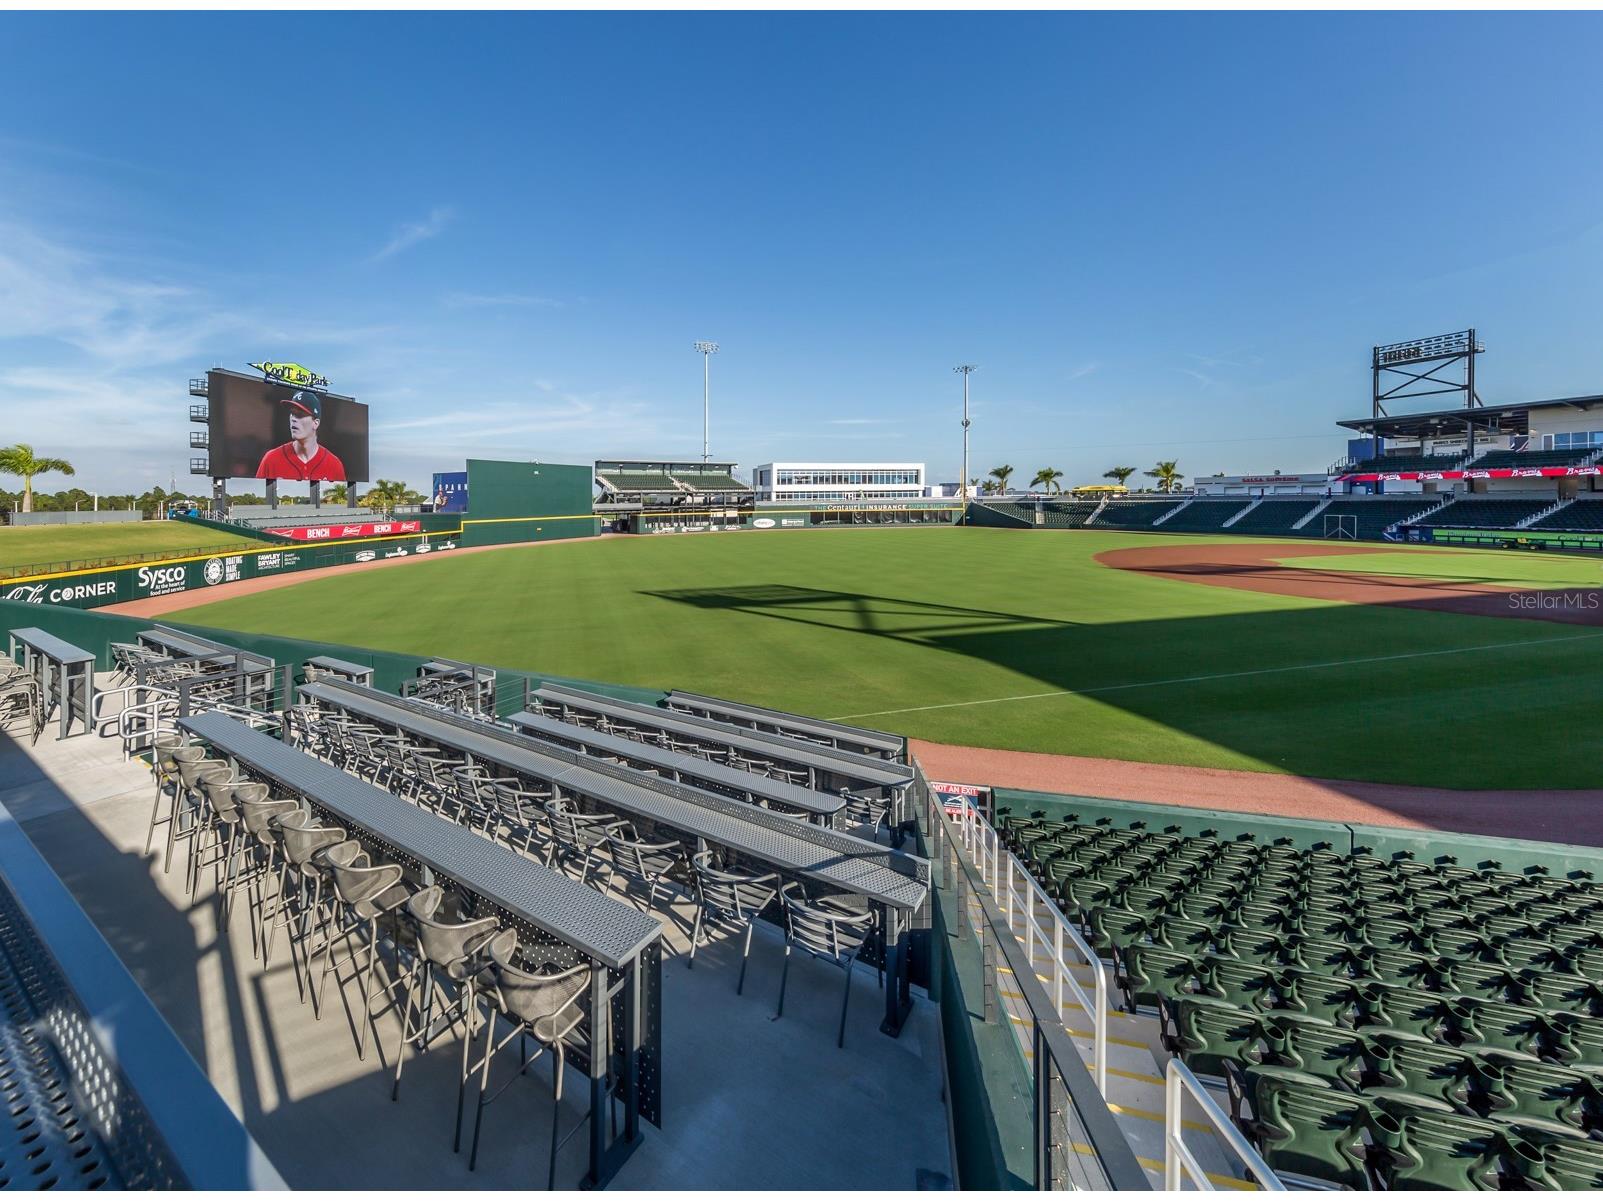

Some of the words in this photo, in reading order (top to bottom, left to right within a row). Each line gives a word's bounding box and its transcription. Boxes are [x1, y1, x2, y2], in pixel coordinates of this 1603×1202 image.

[262, 361, 310, 384] CoolTday
[307, 528, 329, 538] BENCH
[374, 524, 391, 533] BENCH
[50, 581, 116, 603] CORNER
[961, 787, 977, 796] EXIT
